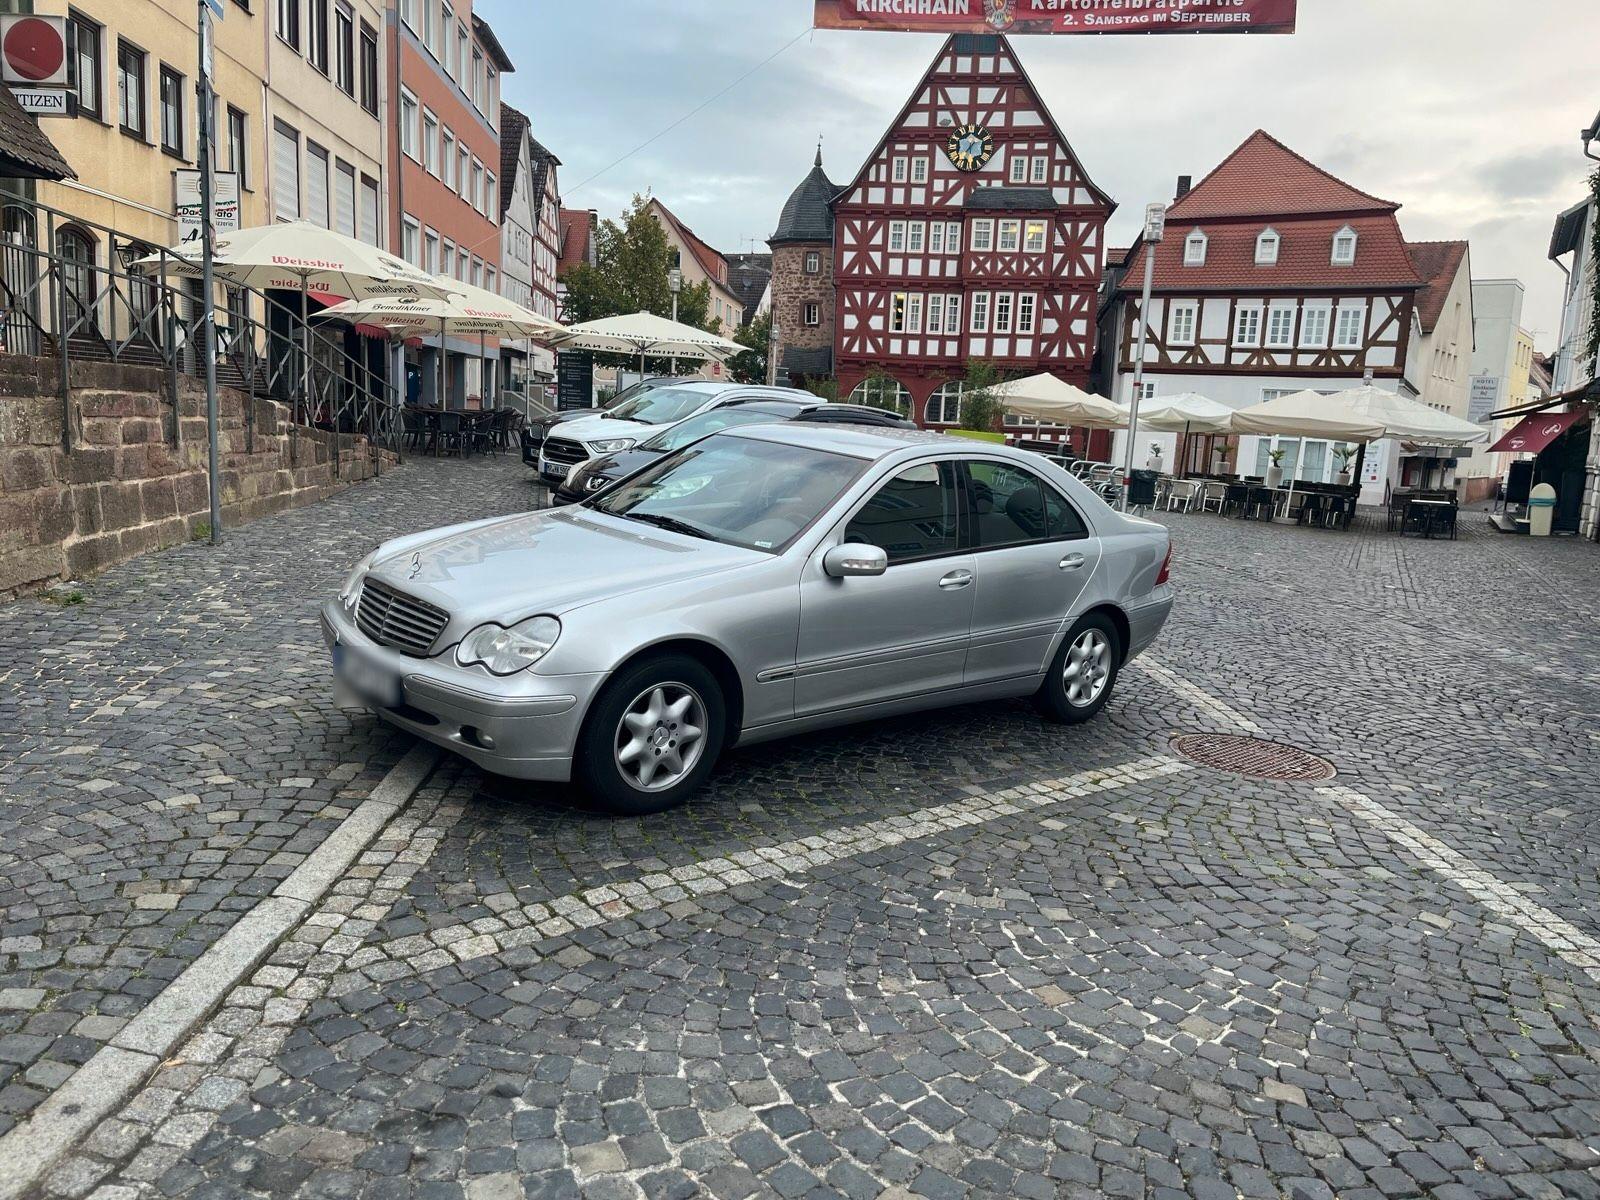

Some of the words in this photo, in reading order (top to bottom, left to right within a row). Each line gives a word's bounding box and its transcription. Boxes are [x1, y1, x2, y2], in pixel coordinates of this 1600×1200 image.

[856, 0, 969, 14] KIRCHHAIN
[1063, 15, 1078, 25] 2.
[16, 94, 63, 107] ITIZEN
[272, 256, 344, 269] Weissbier
